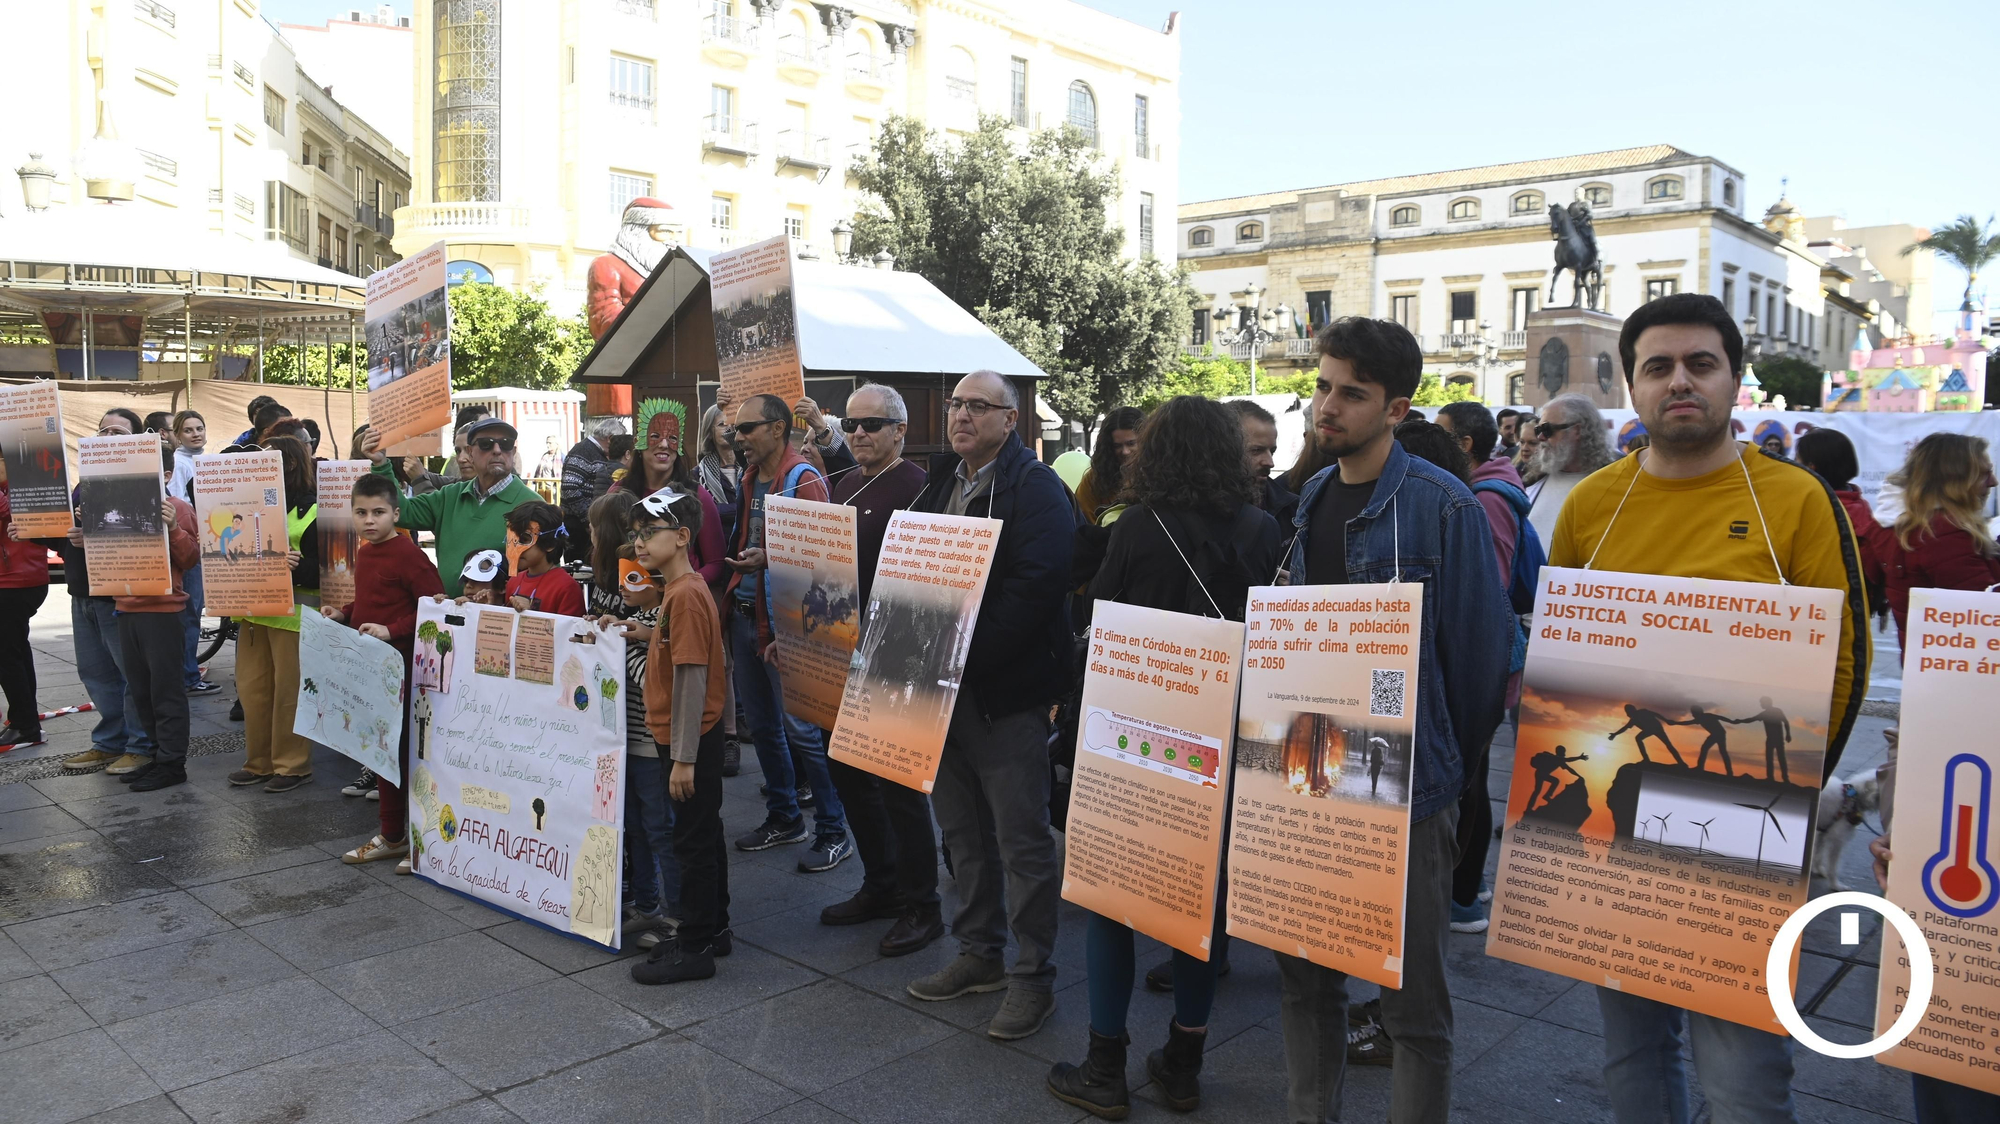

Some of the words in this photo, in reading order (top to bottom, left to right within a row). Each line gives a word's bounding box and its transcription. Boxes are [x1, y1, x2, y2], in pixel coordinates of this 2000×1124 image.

[196, 469, 218, 477] segundo
[767, 503, 775, 511] Las
[776, 505, 810, 517] subvenciones
[811, 510, 816, 518] al
[818, 512, 843, 523] petróleo,
[891, 520, 898, 528] El
[900, 520, 927, 531] Gobierno
[929, 523, 961, 535] Municipal
[962, 528, 970, 536] se
[972, 527, 992, 538] jacta
[770, 555, 793, 565] aprobado
[801, 560, 815, 570] 2015
[879, 568, 907, 579] cobertura
[907, 572, 931, 583] arbórea
[932, 576, 941, 585] de
[941, 577, 948, 586] la
[949, 578, 976, 590] ciudad?
[1251, 599, 1264, 612] Sin
[1267, 599, 1309, 612] medidas
[1312, 599, 1372, 612] adecuadas
[1376, 598, 1410, 612] hasta
[1548, 581, 1566, 595] La
[1572, 583, 1657, 604] JUSTICIA
[1663, 592, 1781, 616] AMBIENTAL
[1789, 606, 1801, 621] y
[1809, 604, 1826, 621] la
[1250, 621, 1260, 630] un
[1270, 618, 1294, 631] 70%
[1304, 618, 1317, 632] de
[1329, 619, 1338, 632] la
[1350, 618, 1409, 636] población
[1544, 603, 1627, 624] JUSTICIA
[1641, 613, 1713, 633] SOCIAL
[1729, 621, 1791, 642] deben
[1809, 629, 1825, 645] ir
[1095, 628, 1103, 639] El
[1104, 630, 1127, 644] clima
[1129, 637, 1140, 647] en
[1143, 637, 1181, 655] Córdoba
[1184, 648, 1196, 658] en
[1199, 648, 1230, 664] 2100:
[1249, 636, 1277, 652] podría
[1284, 638, 1312, 651] sufrir
[1319, 639, 1348, 653] clima
[1356, 642, 1408, 655] extremo
[1541, 625, 1562, 640] de
[1567, 627, 1582, 642] la
[1587, 633, 1637, 649] mano
[1922, 632, 1976, 649] poda
[1093, 644, 1103, 656] 79
[1109, 650, 1140, 664] noches
[1147, 656, 1194, 676] tropicales
[1202, 669, 1208, 681] y
[1216, 670, 1228, 683] 61
[1247, 658, 1258, 668] en
[1261, 656, 1285, 670] 2050
[1920, 657, 1969, 672] para
[1091, 660, 1108, 674] días
[1109, 667, 1115, 676] a
[1117, 667, 1135, 681] más
[1137, 671, 1149, 684] de
[1151, 674, 1163, 687] 40
[1165, 680, 1199, 695] grados
[1274, 693, 1299, 702] Vanguardia,
[1312, 696, 1338, 704] septiembre
[1347, 698, 1359, 706] 2024
[1112, 711, 1144, 725] Temperaturas
[1153, 724, 1171, 732] agosto
[459, 817, 491, 849] AFA
[427, 840, 445, 873] Con
[448, 844, 460, 879] la
[462, 856, 510, 895] Capacidad
[516, 885, 530, 903] de
[1510, 850, 1547, 864] proceso
[1550, 857, 1563, 868] de
[1567, 862, 1632, 884] reconversión,
[1637, 877, 1653, 887] así
[1656, 882, 1685, 895] como
[1690, 889, 1696, 897] a
[1702, 889, 1717, 902] las
[1722, 894, 1764, 912] familias
[1769, 907, 1790, 919] con
[1505, 890, 1549, 908] viviendas.
[1924, 911, 1998, 936] Plataforma
[1498, 932, 1542, 952] transición
[1544, 946, 1596, 966] mejorando
[1599, 961, 1611, 970] su
[1614, 965, 1650, 981] calidad
[1653, 973, 1667, 985] de
[1670, 979, 1695, 993] vida.
[1928, 1013, 1985, 1033] someter
[1919, 1026, 1985, 1050] momento
